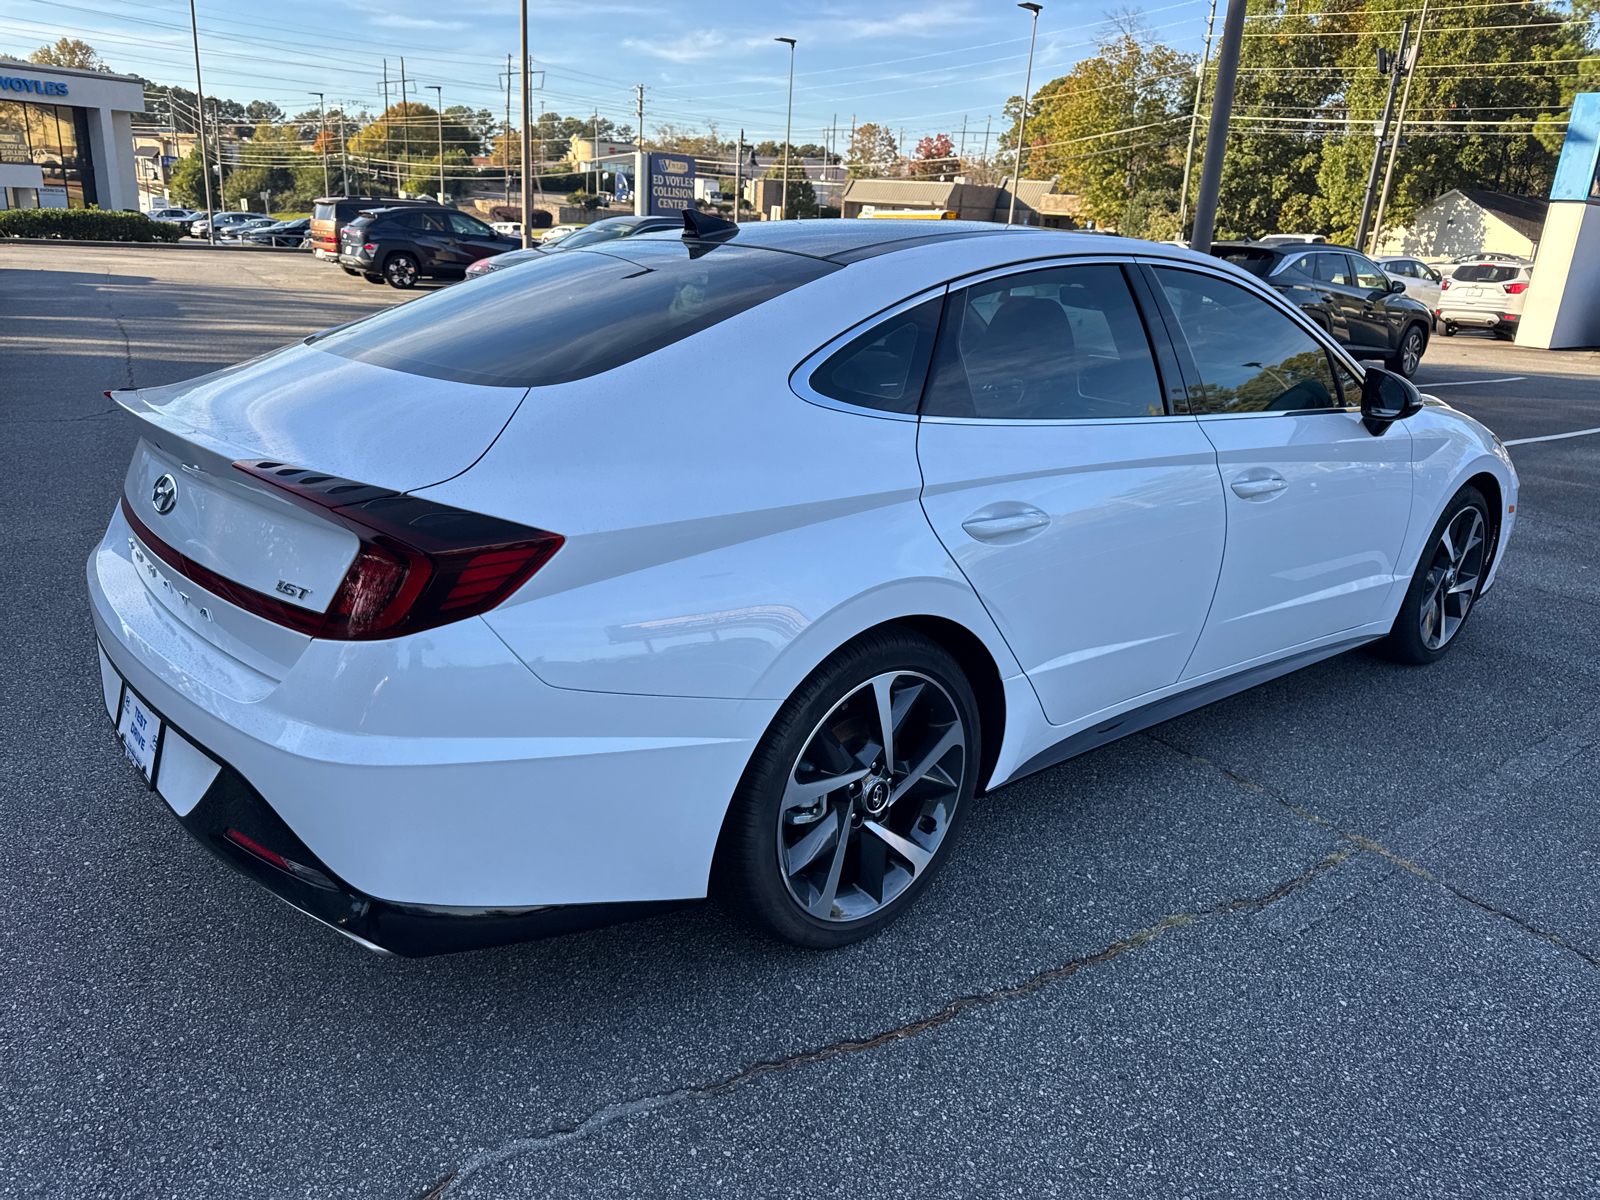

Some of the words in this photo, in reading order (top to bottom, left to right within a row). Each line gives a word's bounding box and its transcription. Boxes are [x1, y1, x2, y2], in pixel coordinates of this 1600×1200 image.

[0, 76, 69, 96] VOYLES
[653, 175, 664, 185] ED
[665, 176, 694, 187] VOYLES
[653, 186, 694, 199] COLLISION
[658, 198, 688, 209] CENTER
[135, 705, 148, 731] TEST
[130, 721, 146, 752] DRIVE
